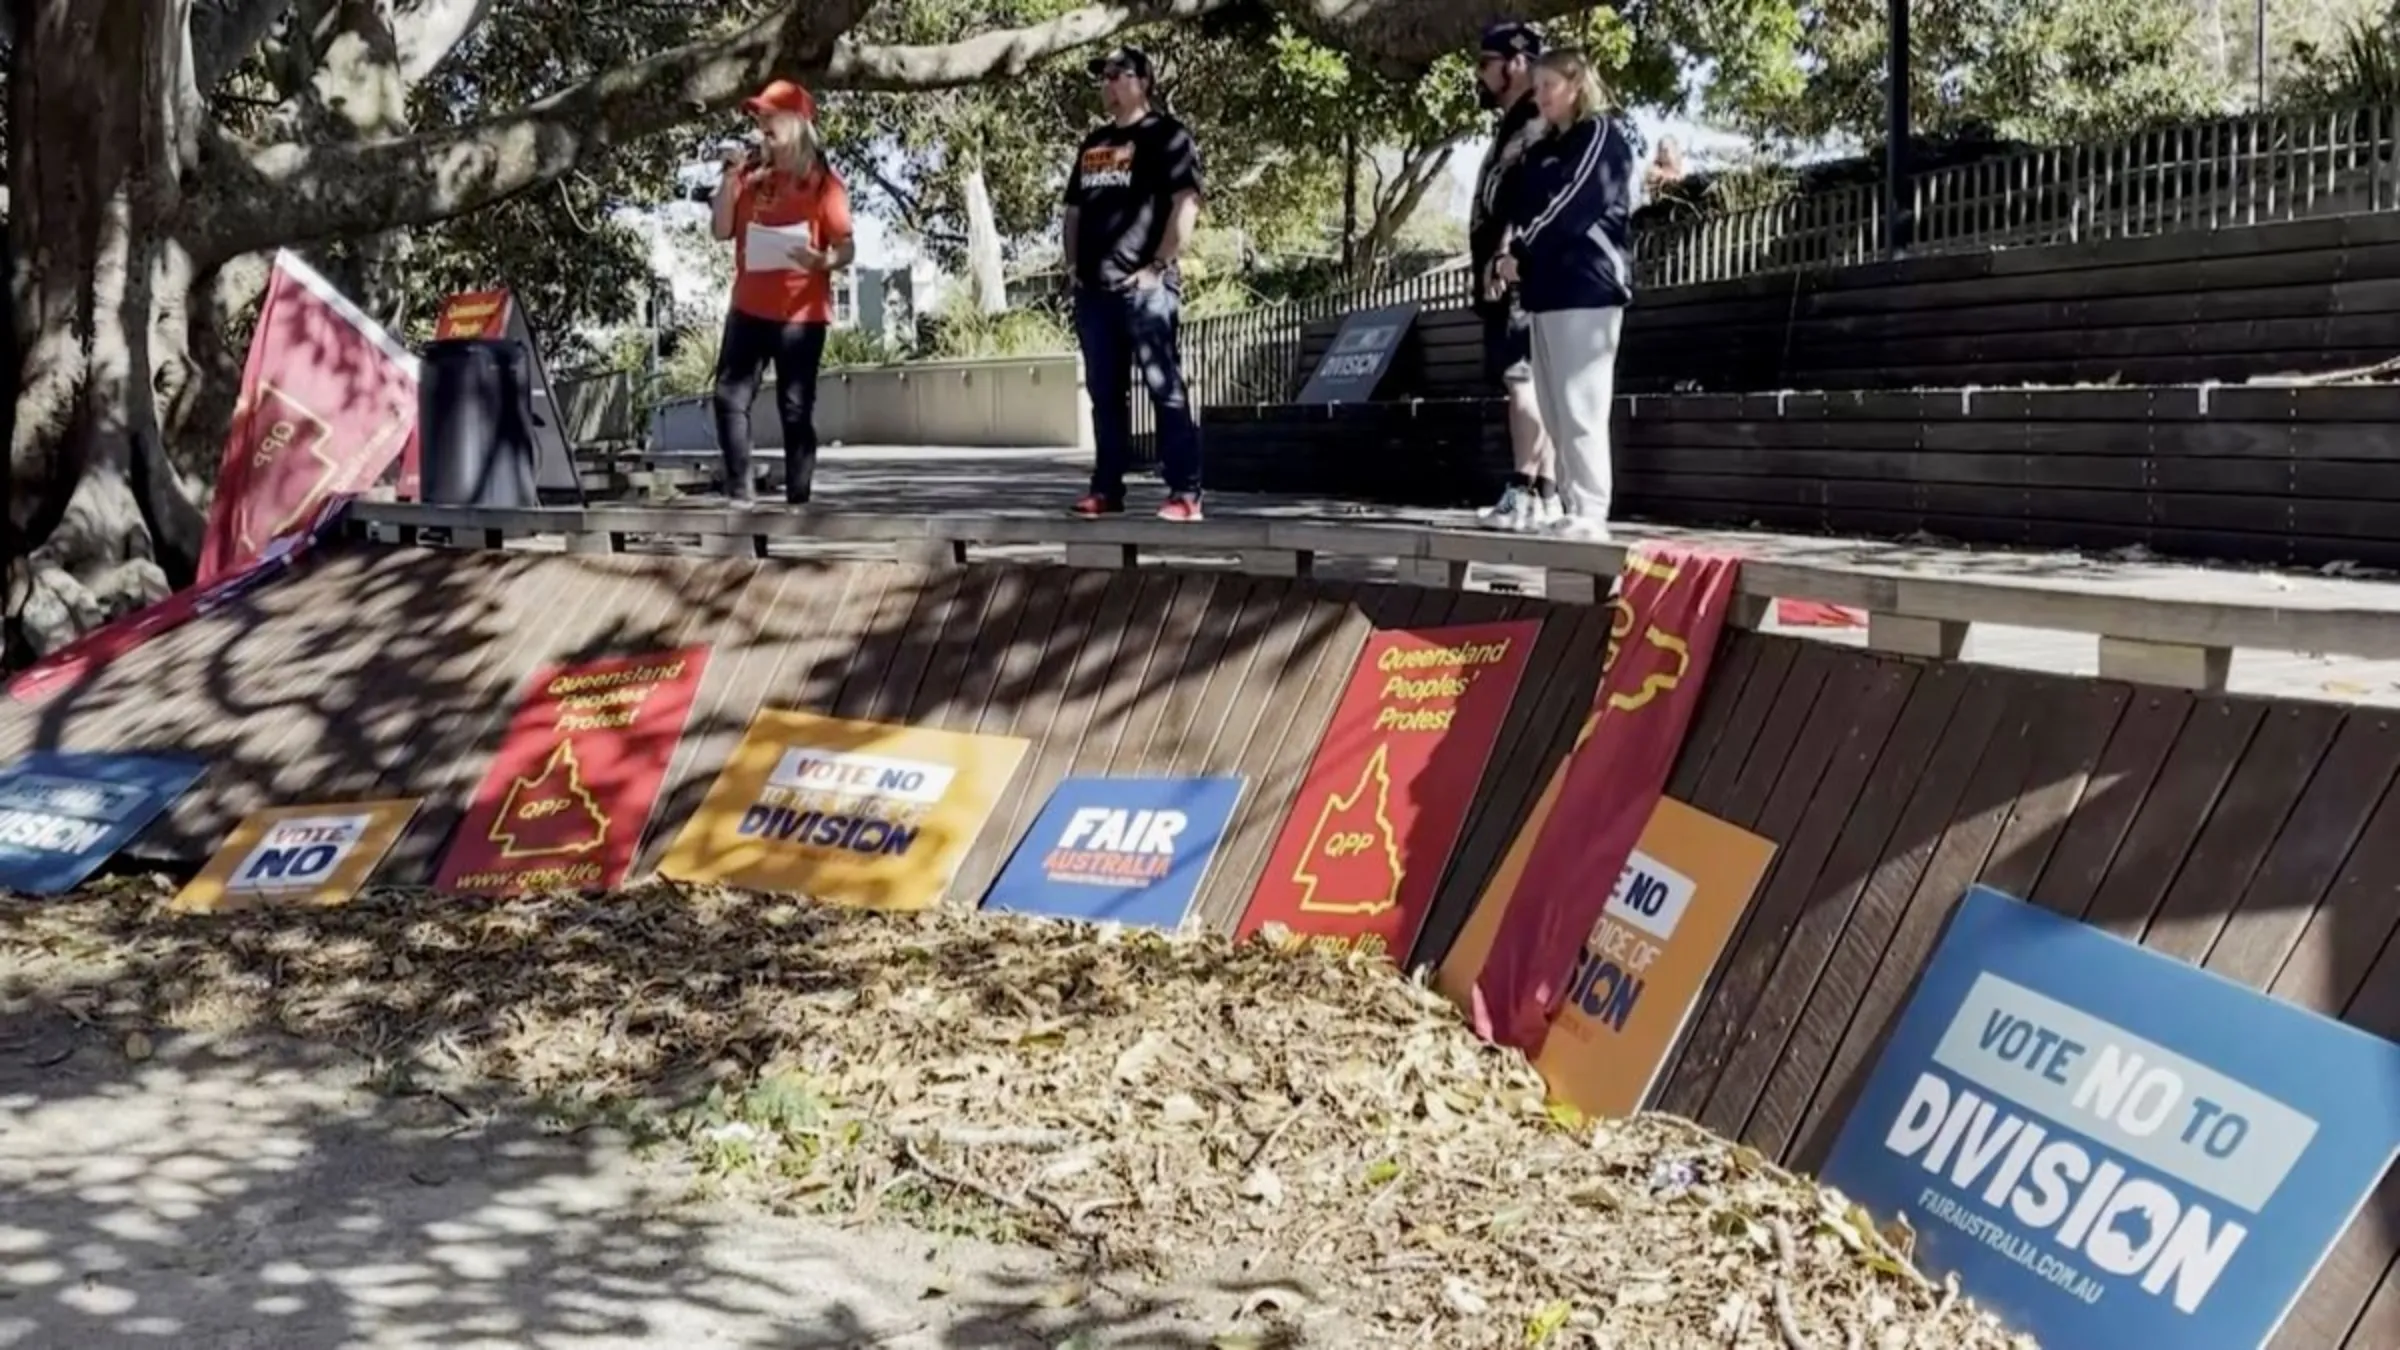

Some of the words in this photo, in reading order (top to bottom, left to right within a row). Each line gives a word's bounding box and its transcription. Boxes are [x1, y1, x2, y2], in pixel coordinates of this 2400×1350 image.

[1377, 637, 1511, 672] Queensland
[548, 659, 686, 694] Queensland
[1379, 669, 1480, 703] Peoples'
[553, 707, 641, 733] Protest
[1373, 705, 1456, 731] Protest
[796, 758, 876, 783] VOTE
[877, 767, 925, 792] NO
[519, 798, 572, 820] QPP
[275, 824, 352, 844] VOTE
[737, 803, 920, 856] DIVISION
[1057, 807, 1188, 854] FAIR
[1325, 832, 1375, 857] QPP
[246, 845, 338, 879] NO
[1624, 871, 1669, 917] NO
[1588, 917, 1635, 962] OICE
[1628, 940, 1662, 974] OF
[1979, 1007, 2086, 1085] VOTE
[2072, 1043, 2184, 1137] NO
[2180, 1096, 2250, 1159] TO
[1884, 1071, 2248, 1316] DIVISION
[1917, 1187, 2104, 1305] FAIRAUSTRALIA.COM.AU
